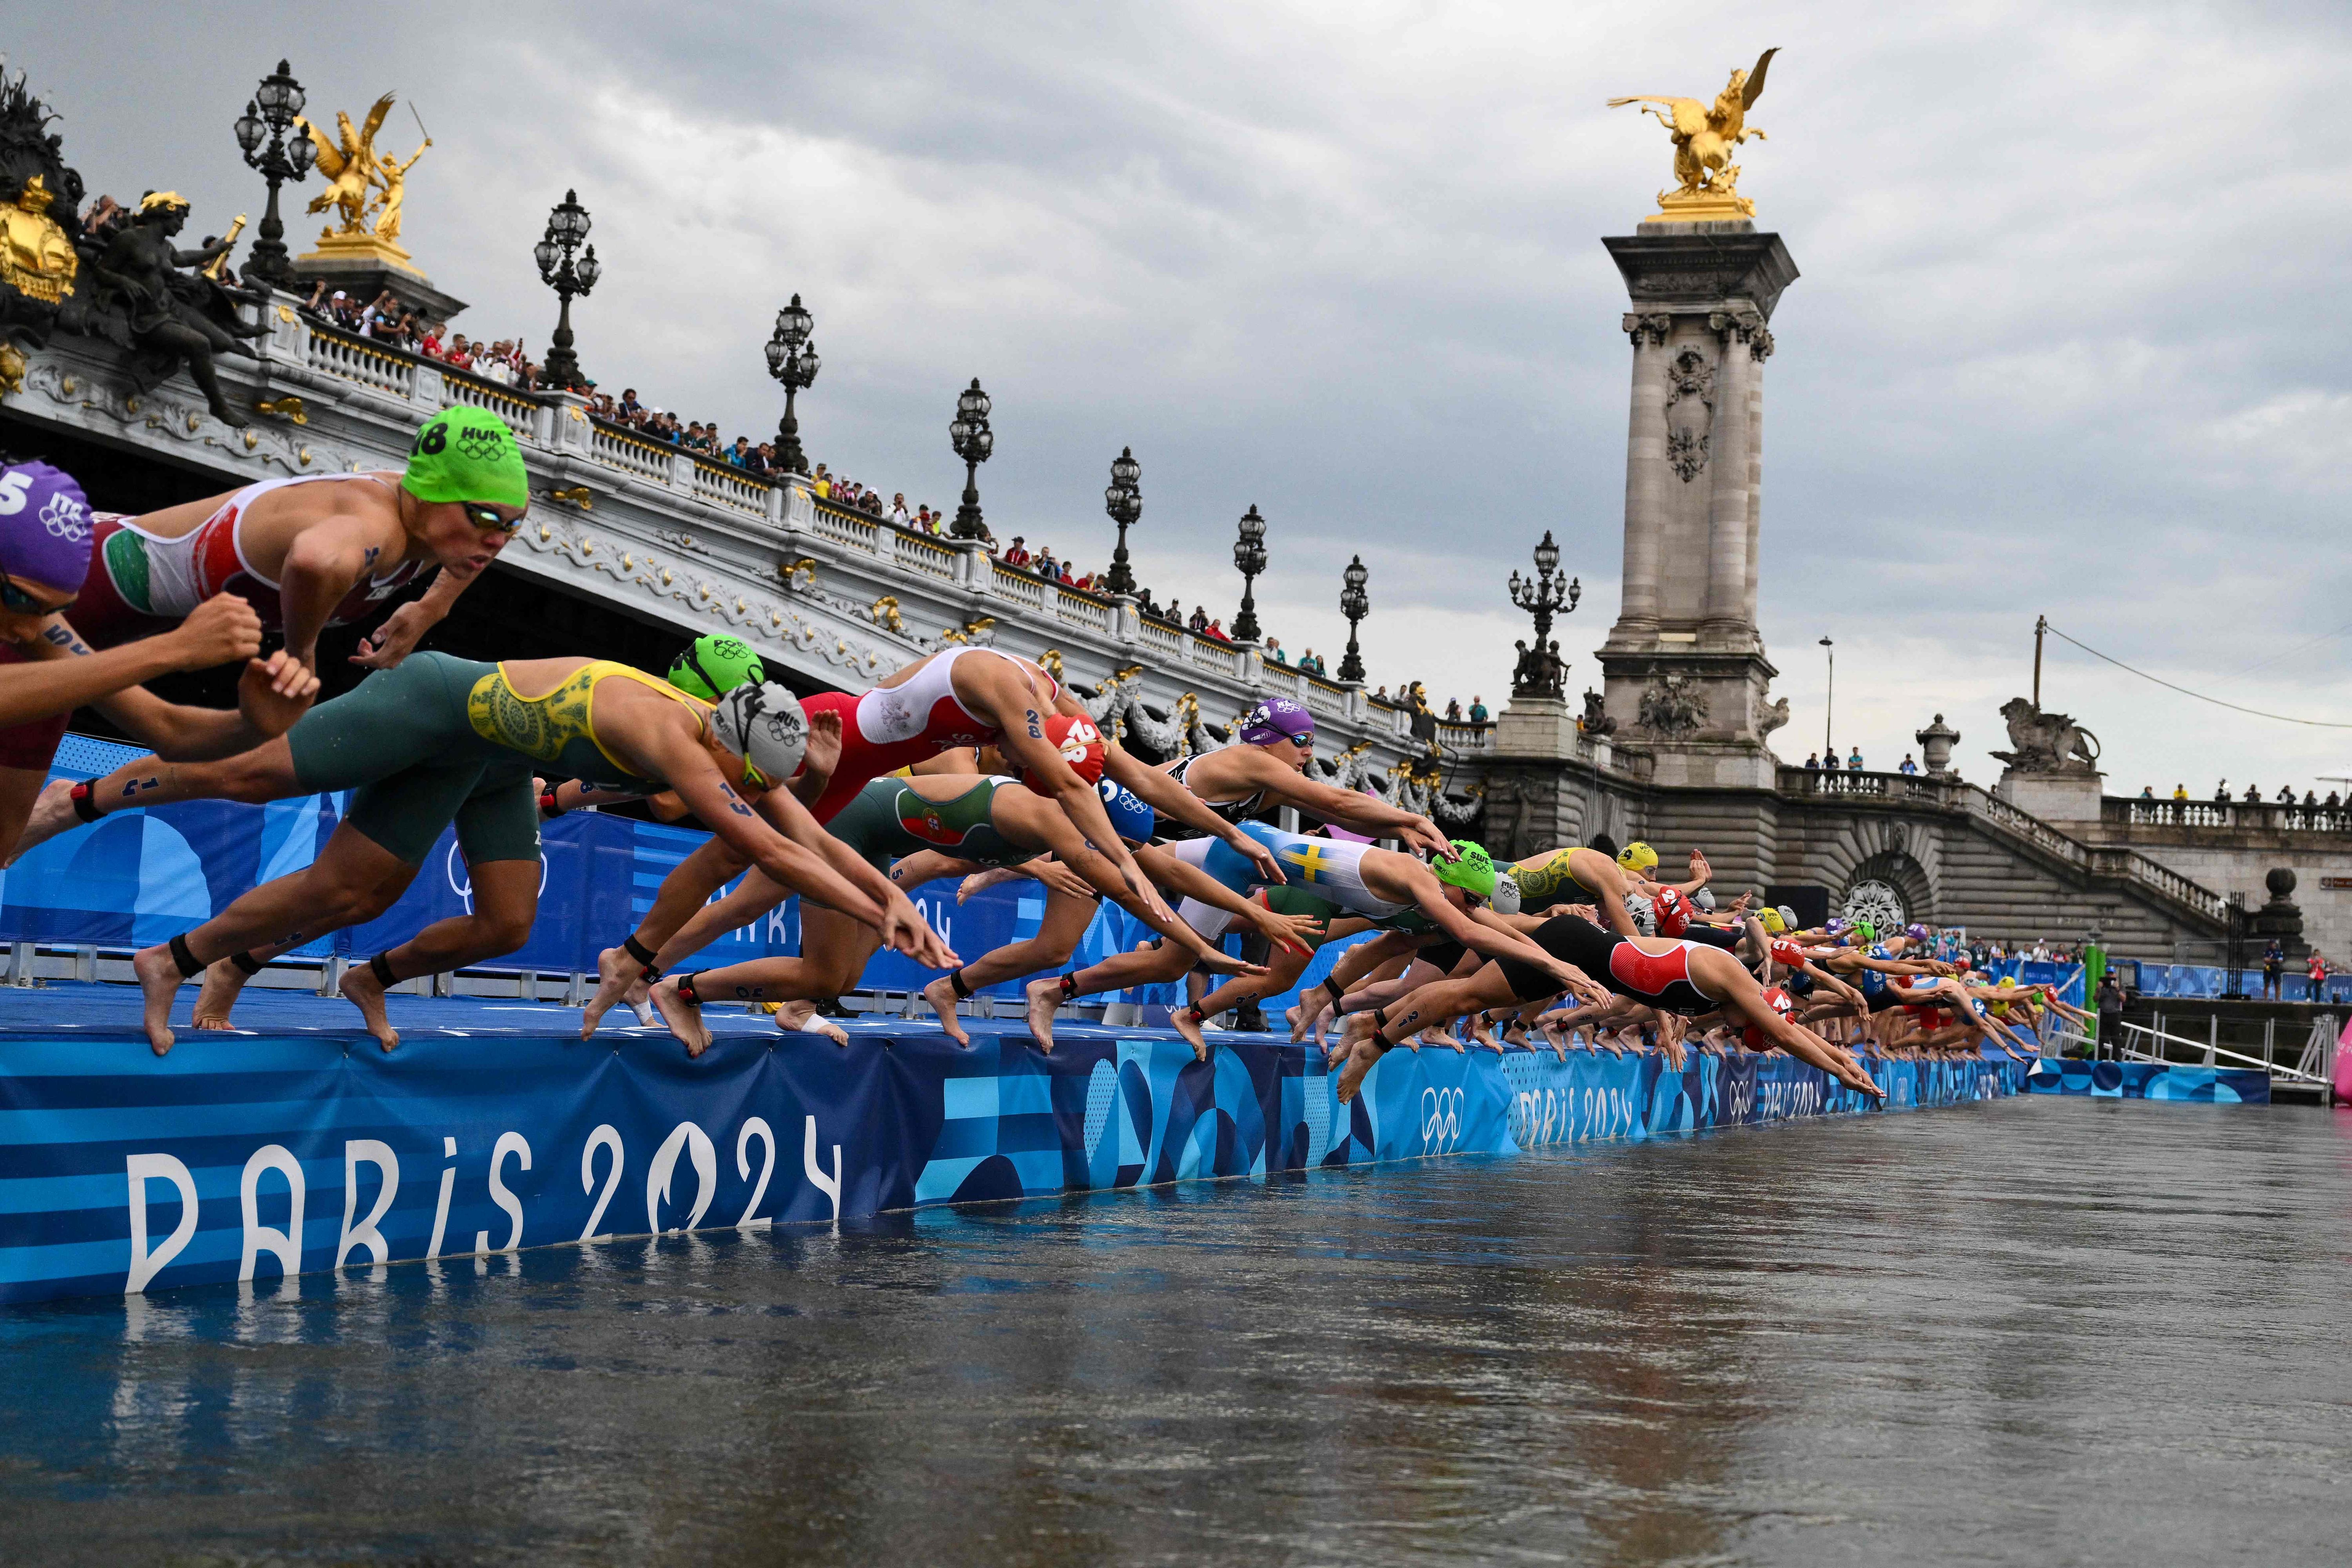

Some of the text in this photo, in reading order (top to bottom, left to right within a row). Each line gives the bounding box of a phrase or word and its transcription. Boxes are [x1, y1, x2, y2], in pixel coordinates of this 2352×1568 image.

[775, 711, 800, 731] AUS
[1026, 709, 1042, 739] 28
[1470, 851, 1489, 865] SWE
[1501, 881, 1517, 891] MEX
[1578, 1087, 1632, 1141] 2024
[578, 1115, 841, 1243] 2024
